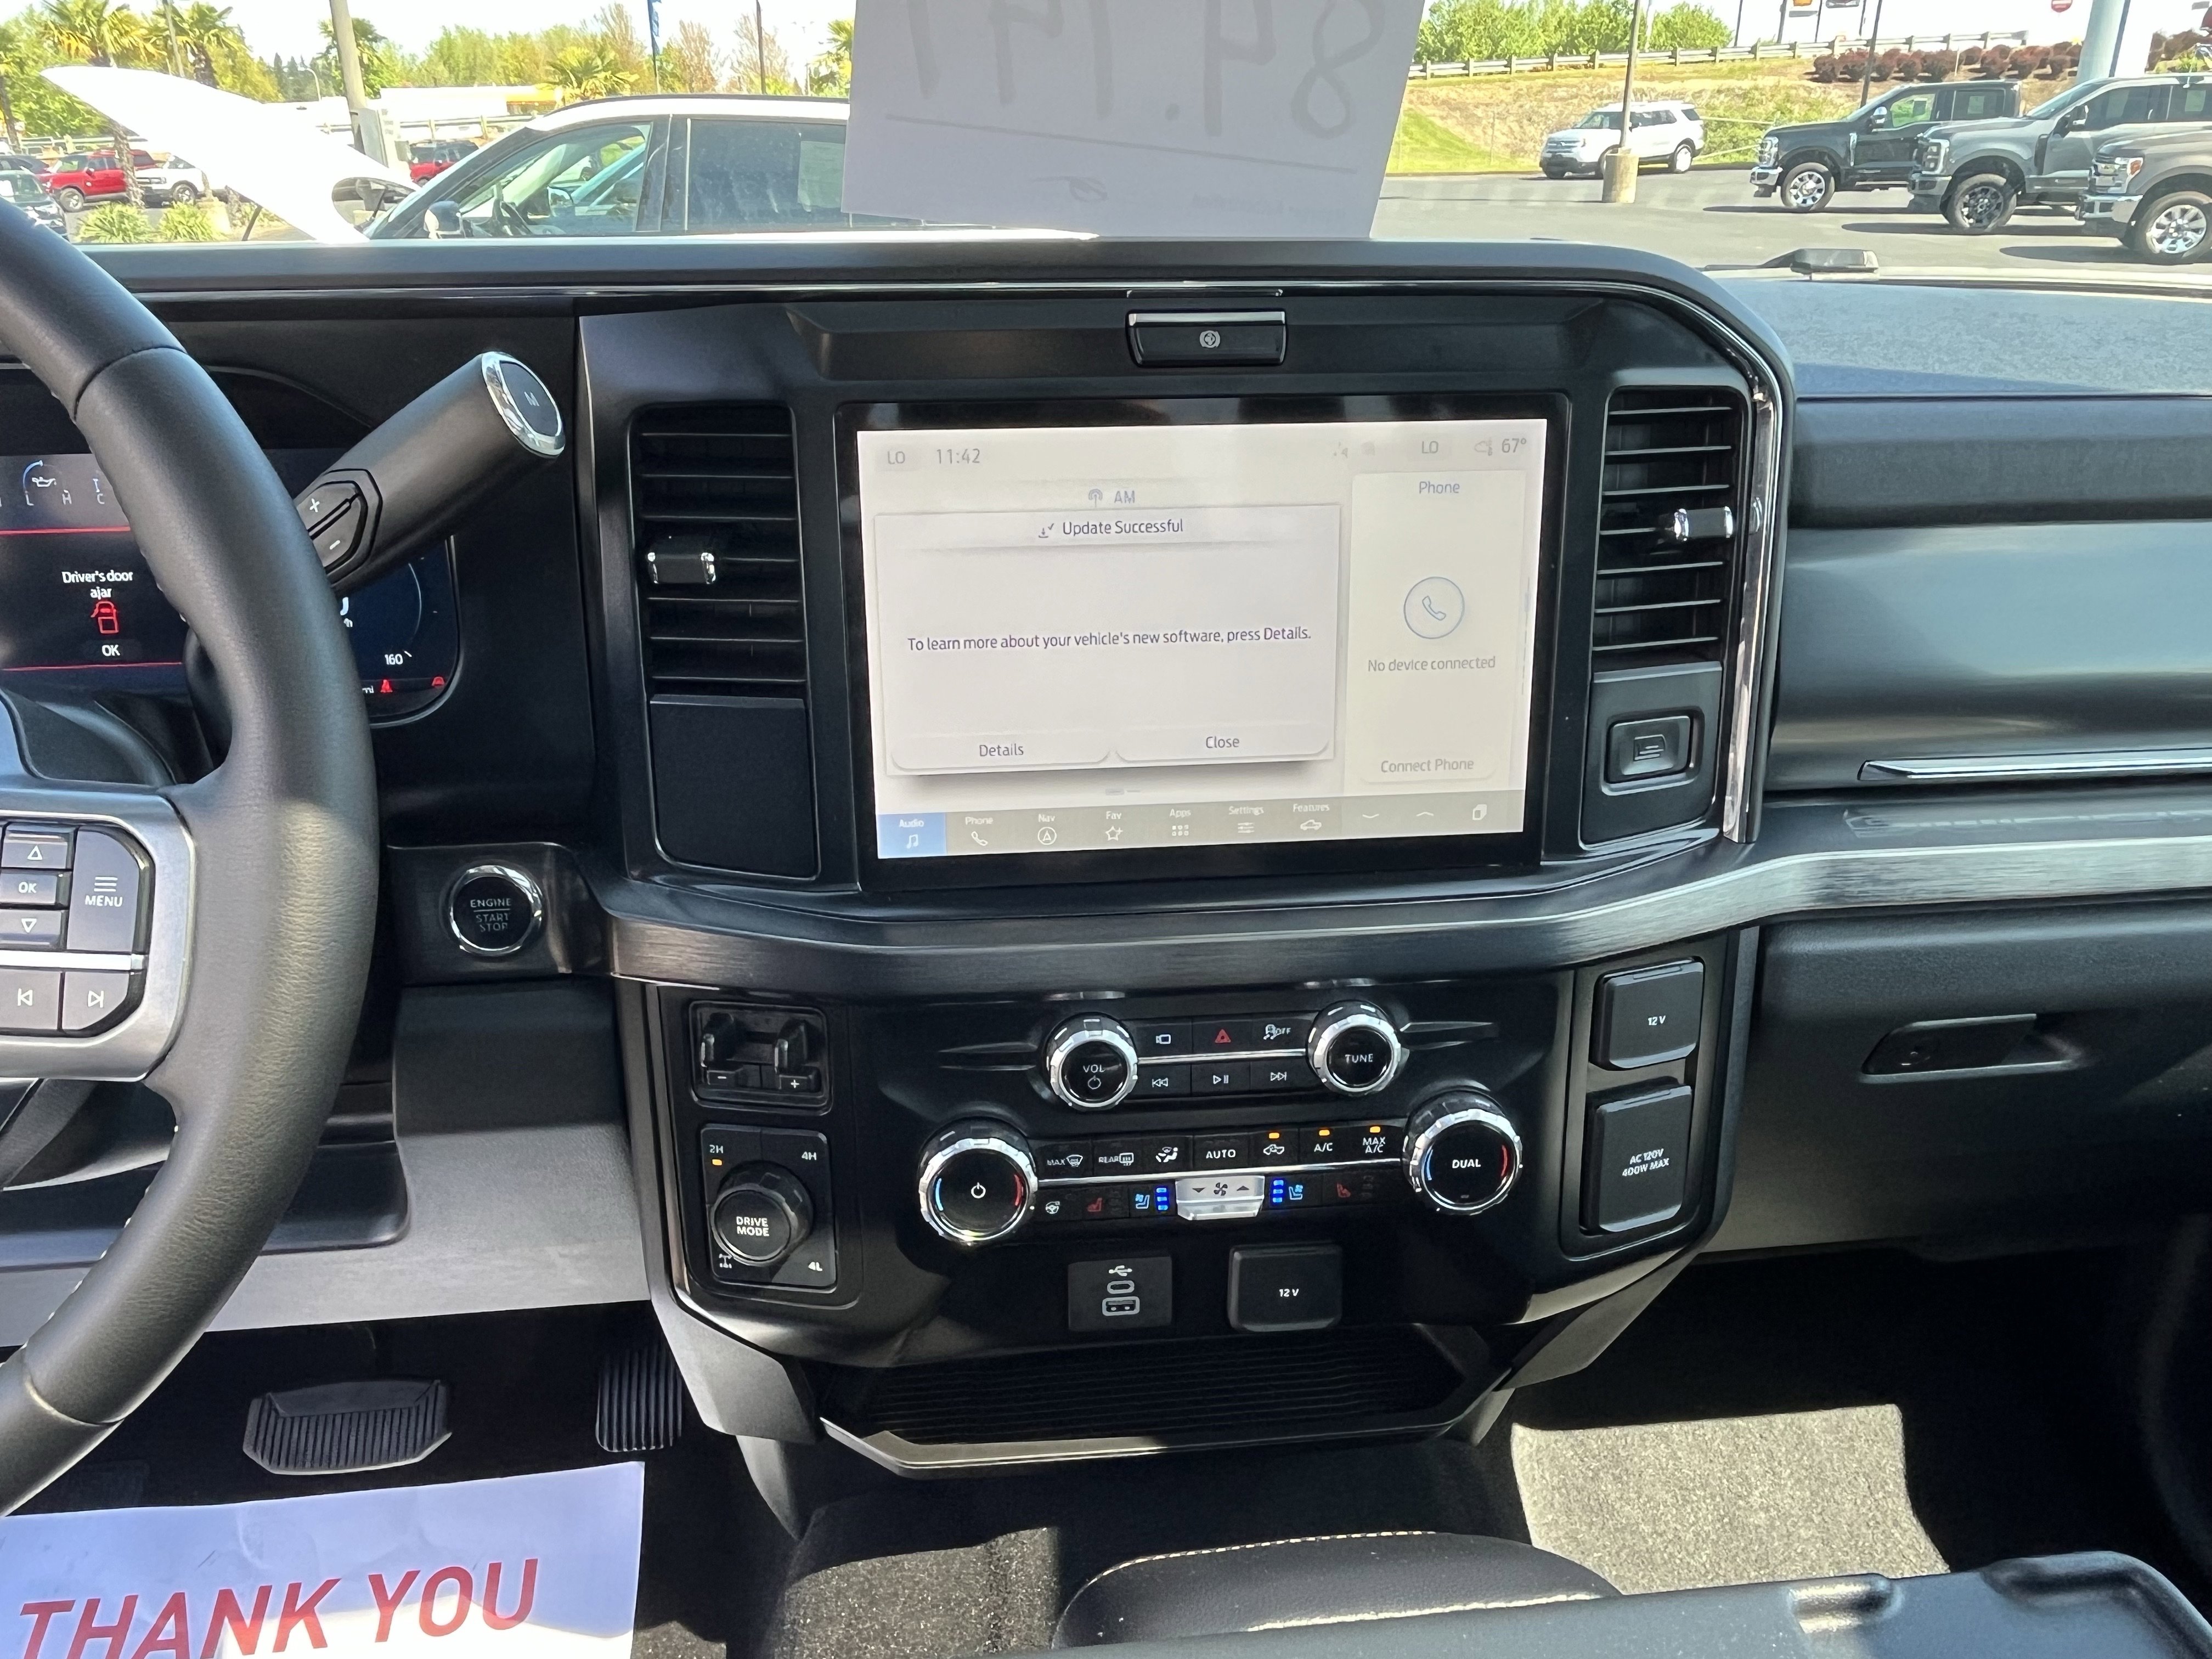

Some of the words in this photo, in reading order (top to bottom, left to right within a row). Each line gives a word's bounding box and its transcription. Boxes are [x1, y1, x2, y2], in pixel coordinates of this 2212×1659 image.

[1421, 440, 1439, 454] LO
[887, 450, 906, 465] LO
[936, 448, 981, 465] 11:42
[1419, 481, 1460, 494] Phone
[1114, 490, 1136, 504] AM
[1063, 521, 1111, 537] Update
[1114, 518, 1183, 534] Successful
[61, 571, 105, 583] Driver's
[106, 570, 133, 582] door
[90, 586, 112, 600] ajar
[908, 637, 924, 651] To
[927, 636, 960, 650] learn
[963, 637, 997, 650] more
[1001, 634, 1040, 648] about
[1042, 635, 1071, 651] your
[1074, 631, 1130, 646] vehicle's
[1133, 633, 1160, 645] new
[1163, 628, 1224, 644] software,
[1227, 629, 1260, 644] press
[1263, 626, 1311, 641] Details.
[101, 645, 120, 656] OK
[385, 654, 403, 665] 160
[1367, 659, 1385, 673] No
[1388, 657, 1428, 671] device
[1430, 655, 1496, 670] connected
[1205, 735, 1240, 749] Close
[979, 743, 1024, 758] Details
[1380, 759, 1431, 774] Connect
[1435, 757, 1474, 771] Phone
[1169, 808, 1192, 819] Apps
[1228, 805, 1264, 816] Settings
[1293, 803, 1330, 813] Features
[965, 815, 994, 826] Phone
[1038, 813, 1056, 823] Nav
[1105, 811, 1122, 821] Fav
[899, 819, 924, 829] Audio
[19, 882, 37, 893] OK
[84, 895, 123, 907] MENU
[470, 898, 511, 907] ENGINE
[476, 913, 509, 922] START
[479, 923, 507, 932] STOP
[1345, 1053, 1374, 1063] TUNE
[1083, 1064, 1105, 1073] VOL
[1363, 1137, 1386, 1146] MAX
[1314, 1142, 1333, 1153] A/C
[1365, 1144, 1384, 1154] A/C
[802, 1152, 816, 1160] 4H
[1206, 1149, 1236, 1159] AUTO
[1629, 1154, 1642, 1164] AC
[1452, 1159, 1482, 1169] DUAL
[736, 1216, 768, 1227] DRIVE
[737, 1226, 769, 1237] MODE
[808, 1262, 822, 1271] 4L
[18, 1578, 341, 1659] THANK
[367, 1558, 539, 1643] YOU
